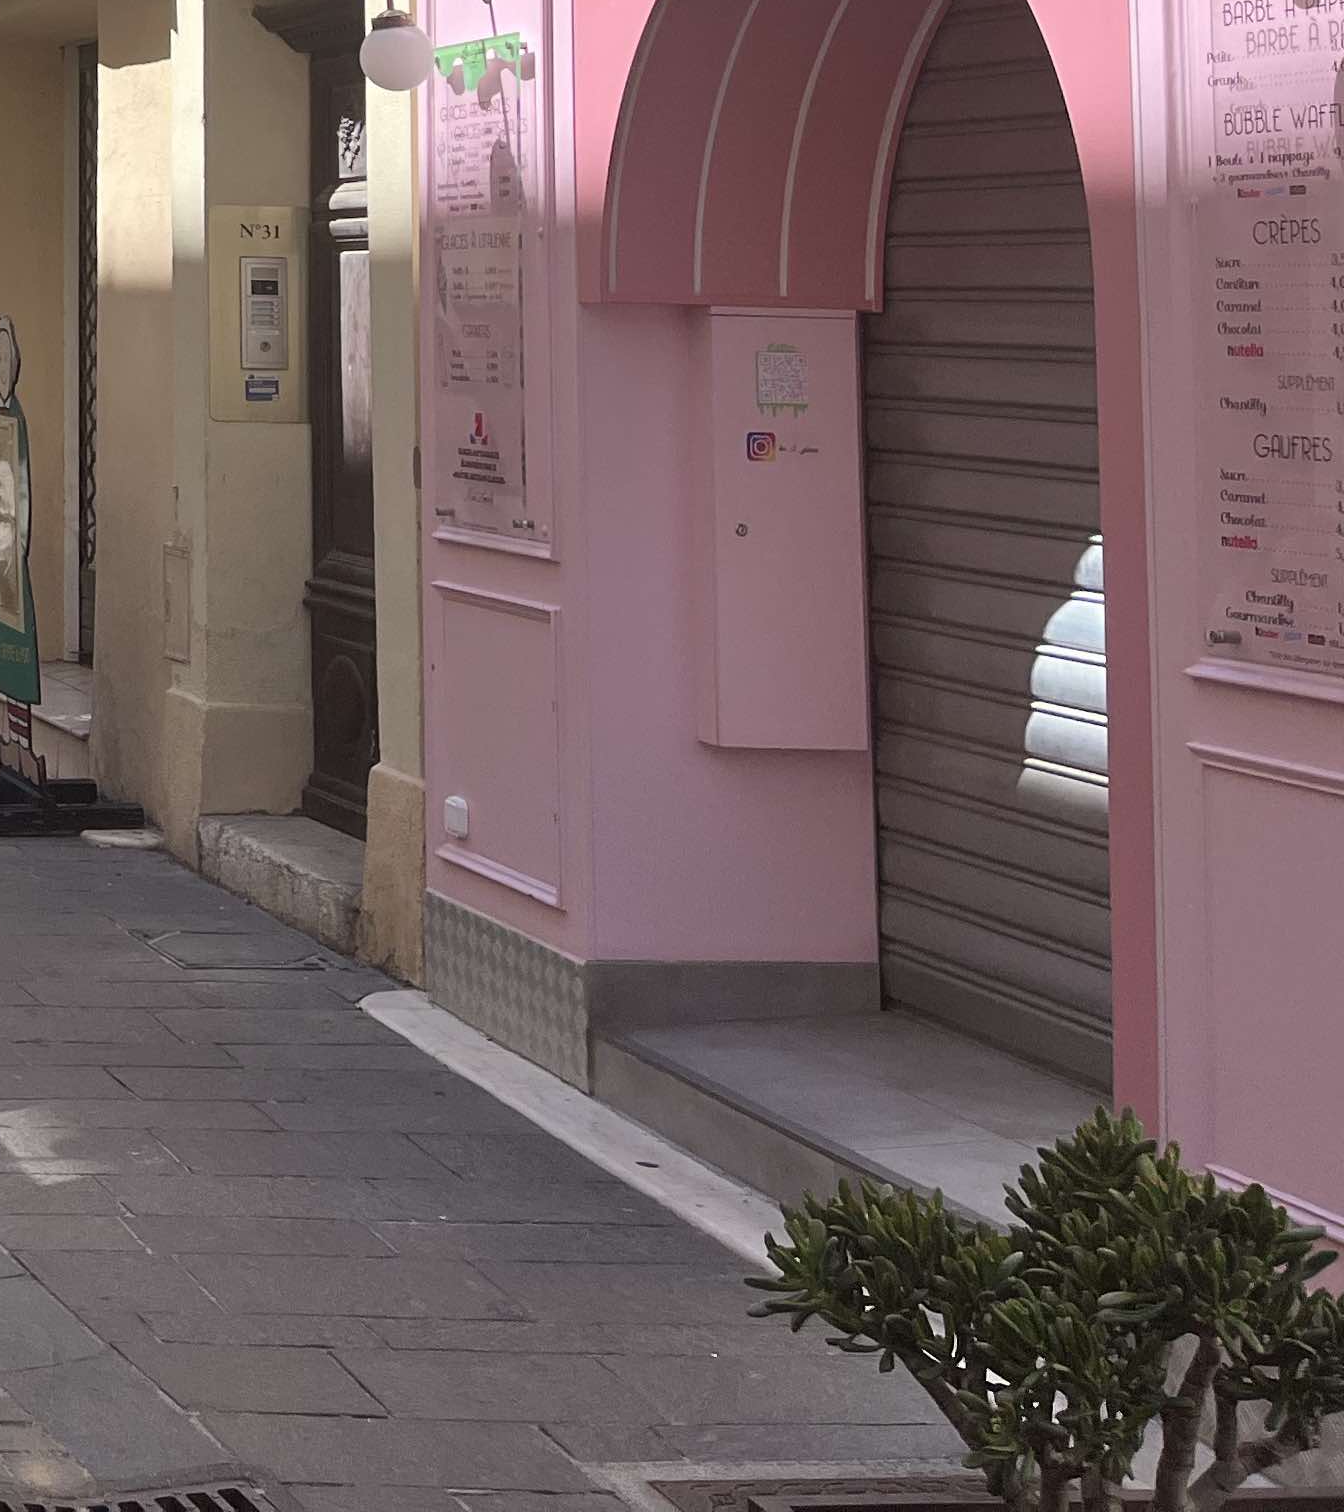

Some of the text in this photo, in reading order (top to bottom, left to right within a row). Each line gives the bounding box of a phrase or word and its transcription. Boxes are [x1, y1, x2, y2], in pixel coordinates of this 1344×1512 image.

[1224, 108, 1283, 136] BUBBLE
[240, 224, 280, 239] N°31
[1216, 300, 1262, 312] Caramel
[1217, 322, 1261, 335] Chocolat
[1227, 344, 1264, 357] nutella
[1220, 397, 1267, 416] Chantilly
[1253, 433, 1333, 462] GAUFRES
[1220, 489, 1265, 504] Caramel
[1220, 512, 1266, 527] Chocolat
[1245, 590, 1294, 613] Chantilly
